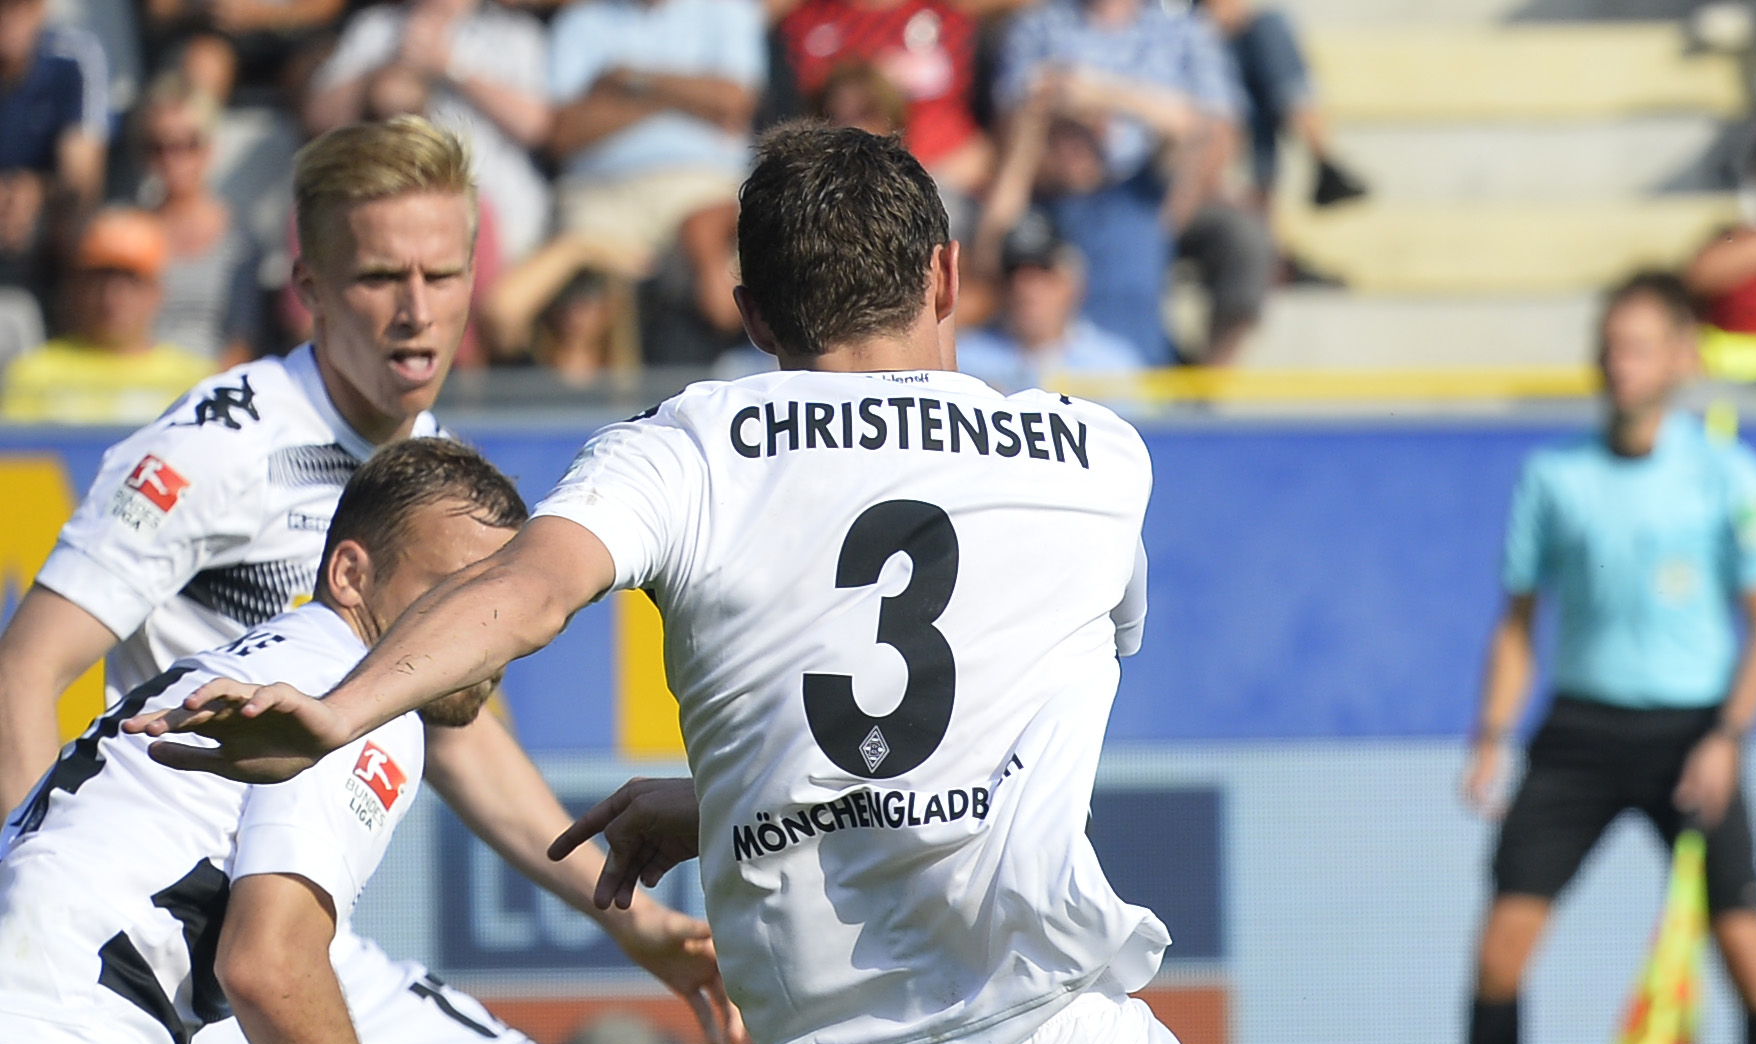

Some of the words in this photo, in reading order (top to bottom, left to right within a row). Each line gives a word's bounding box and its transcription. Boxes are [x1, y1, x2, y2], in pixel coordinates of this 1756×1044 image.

[729, 397, 1091, 470] CHRISTENSEN
[802, 499, 960, 779] 3
[345, 777, 387, 828] BUNDES
[348, 797, 374, 832] LIGA
[732, 752, 1025, 862] MÖNCHENGLADB
